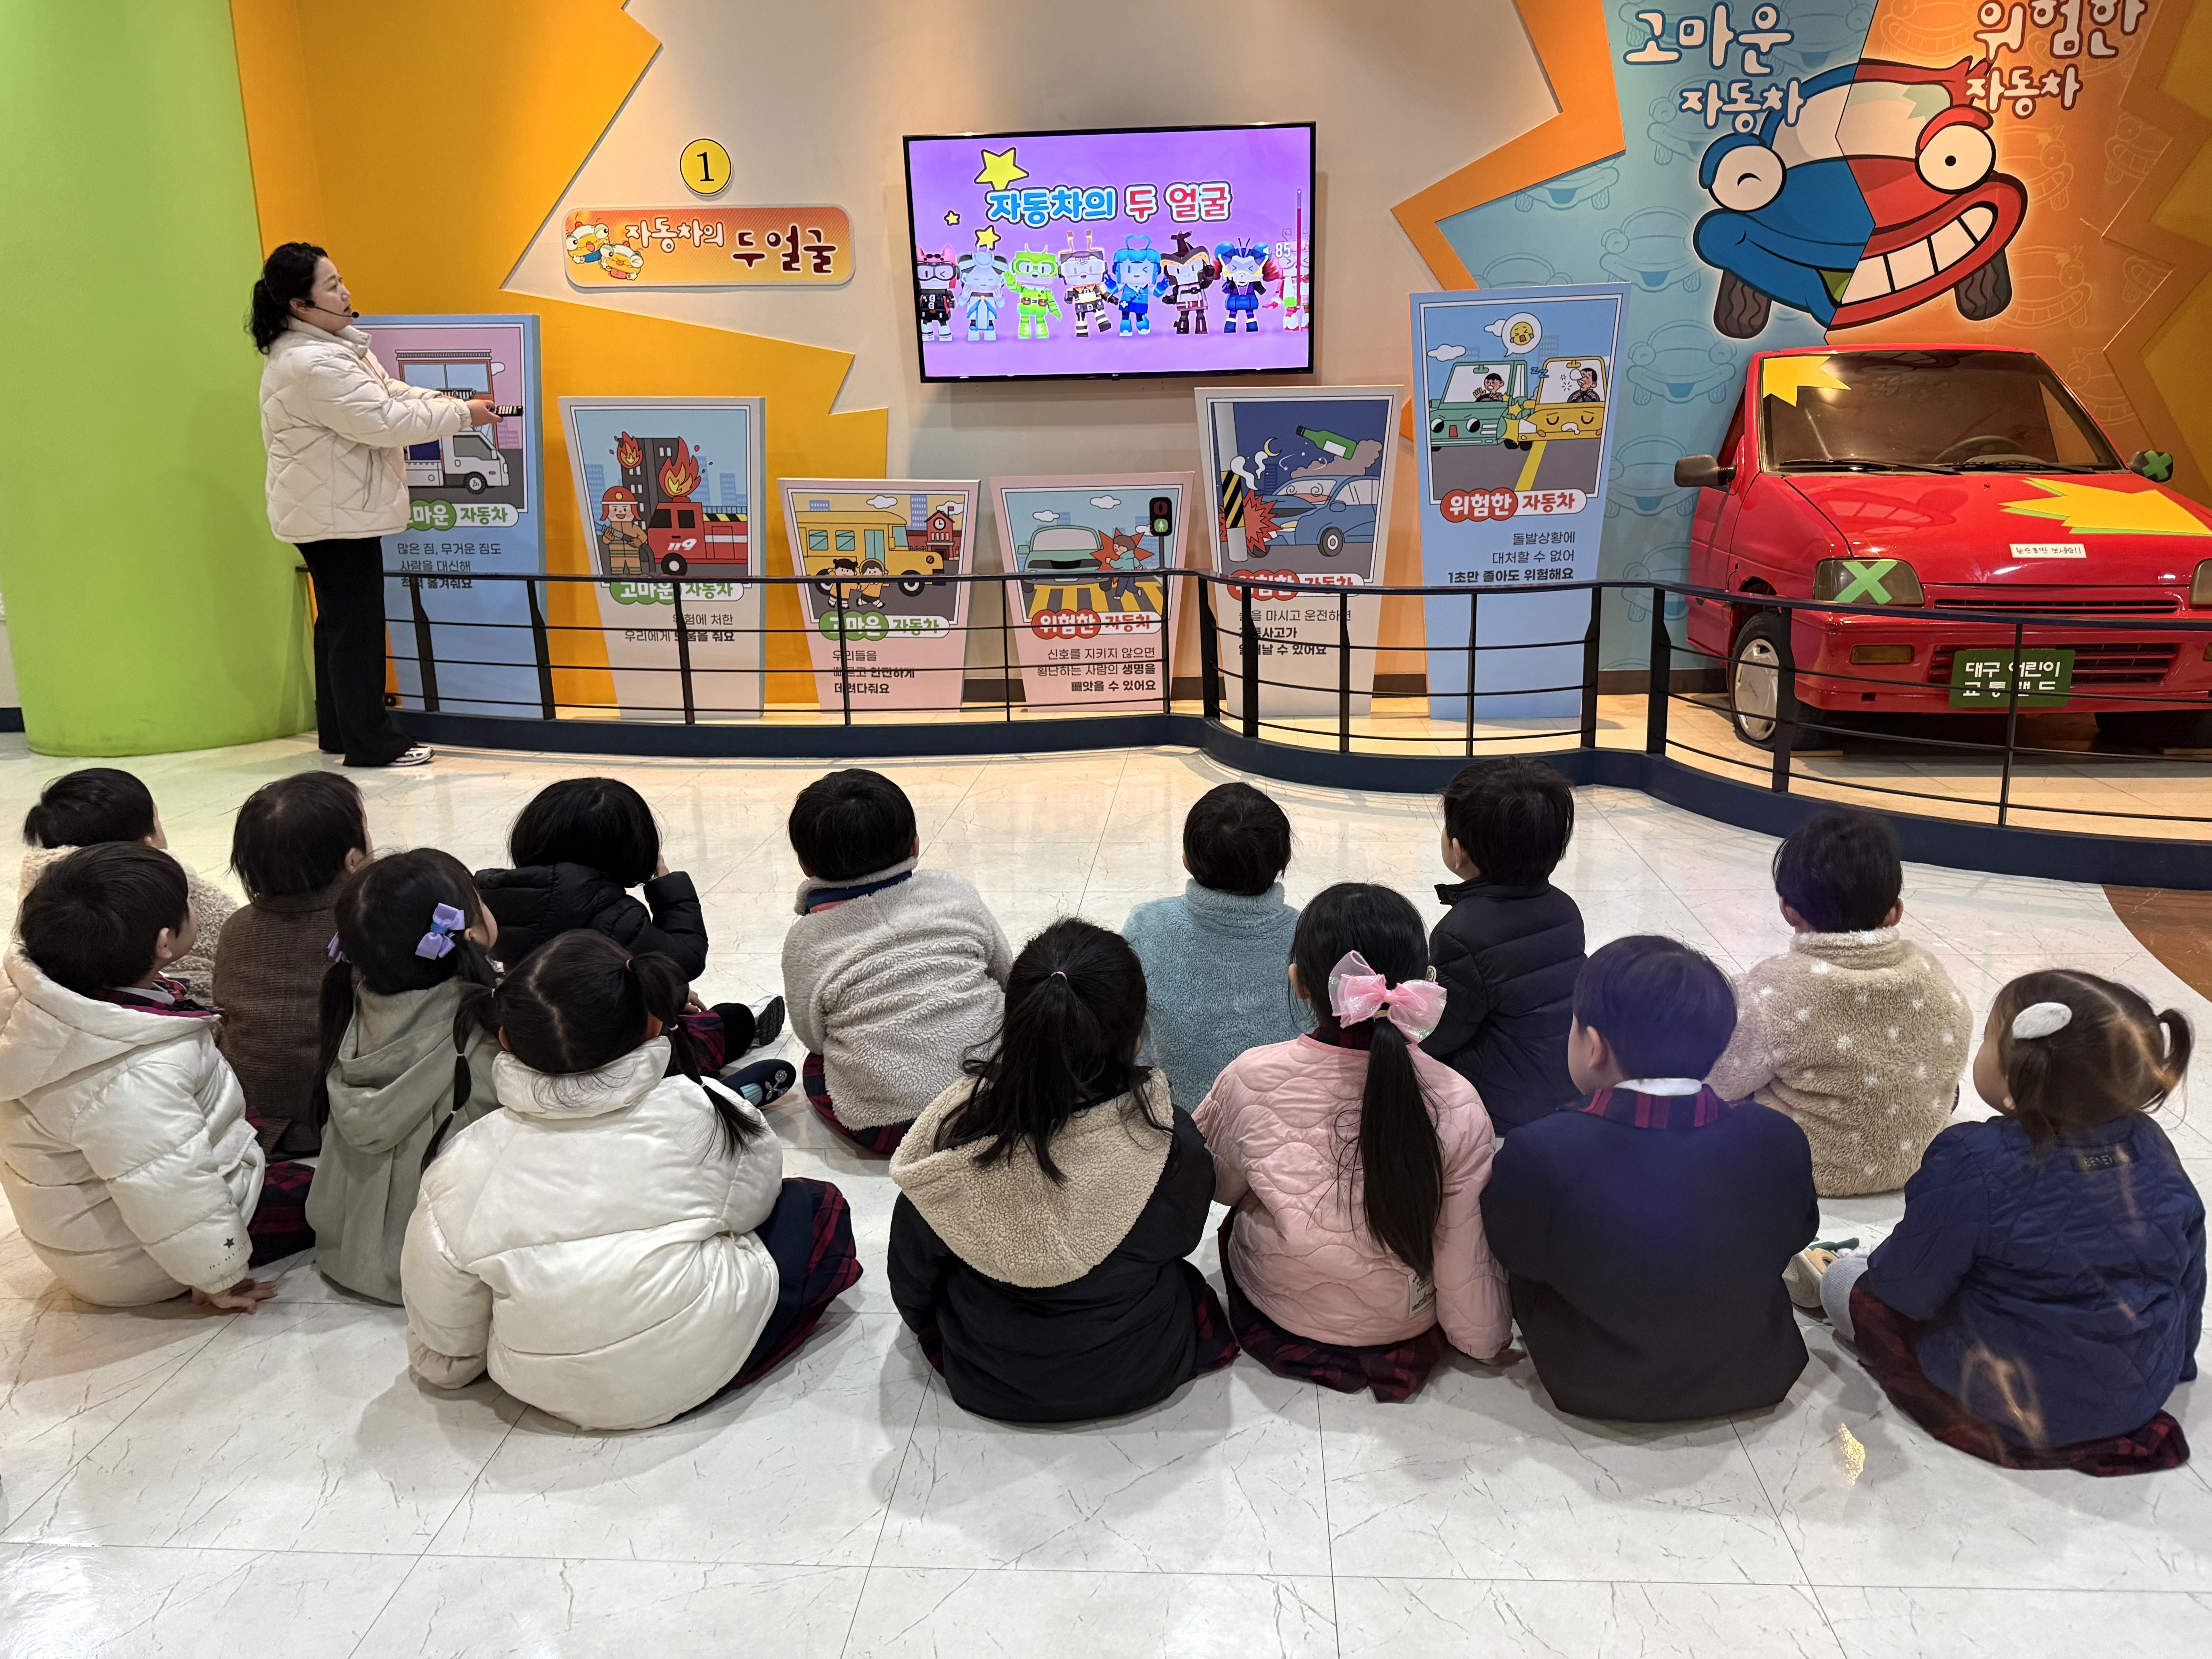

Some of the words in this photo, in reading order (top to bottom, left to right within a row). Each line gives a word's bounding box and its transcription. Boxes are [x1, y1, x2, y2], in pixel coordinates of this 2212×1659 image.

[1623, 2, 1794, 76] 고마운
[1974, 0, 2148, 63] 위험한
[1965, 64, 2083, 119] 자동차
[1679, 78, 1807, 135] 자동차
[697, 151, 714, 182] 1
[988, 188, 1114, 226] 자동차의
[1127, 188, 1155, 220] 두
[1168, 185, 1229, 219] 얼굴
[625, 217, 724, 253] 자동차의
[1275, 242, 1291, 258] 85
[1450, 493, 1512, 517] 위험한
[1523, 492, 1575, 513] 자동차
[408, 504, 449, 526] 마운
[460, 506, 508, 525] 자동차
[667, 538, 697, 551] 119
[1513, 531, 1575, 545] 돌발상황에
[398, 543, 420, 555] 많은
[424, 543, 438, 555] 짐,
[442, 543, 475, 555] 무거운
[479, 543, 502, 555] 짐도
[1492, 551, 1529, 564] 대처할
[1533, 551, 1545, 563] 수
[1551, 550, 1574, 562] 없어
[402, 560, 432, 572] 사람을
[437, 560, 471, 572] 대신해
[1449, 571, 1479, 583] 1초만
[1524, 568, 1574, 581] 위험해요
[620, 582, 674, 600] 고마운
[711, 613, 733, 625] 처한
[1266, 610, 1300, 621] 마시고
[893, 618, 940, 636] 자동차
[1040, 613, 1096, 635] 위험한
[1105, 614, 1151, 632] 자동차
[625, 630, 670, 642] 우리에게
[833, 650, 877, 661] 우리들을
[1048, 648, 1081, 660] 신호를
[1085, 648, 1118, 659] 지키지
[1122, 647, 1155, 658] 않으면
[1277, 644, 1288, 655] 수
[1293, 644, 1327, 655] 있어요
[1037, 665, 1081, 677] 횡단하는
[1085, 664, 1118, 675] 사람의
[1122, 663, 1156, 675] 생명을
[1965, 662, 2000, 678] 대구
[1071, 681, 1104, 692] 빼앗을
[1108, 681, 1119, 691] 수
[1123, 680, 1156, 691] 있어요
